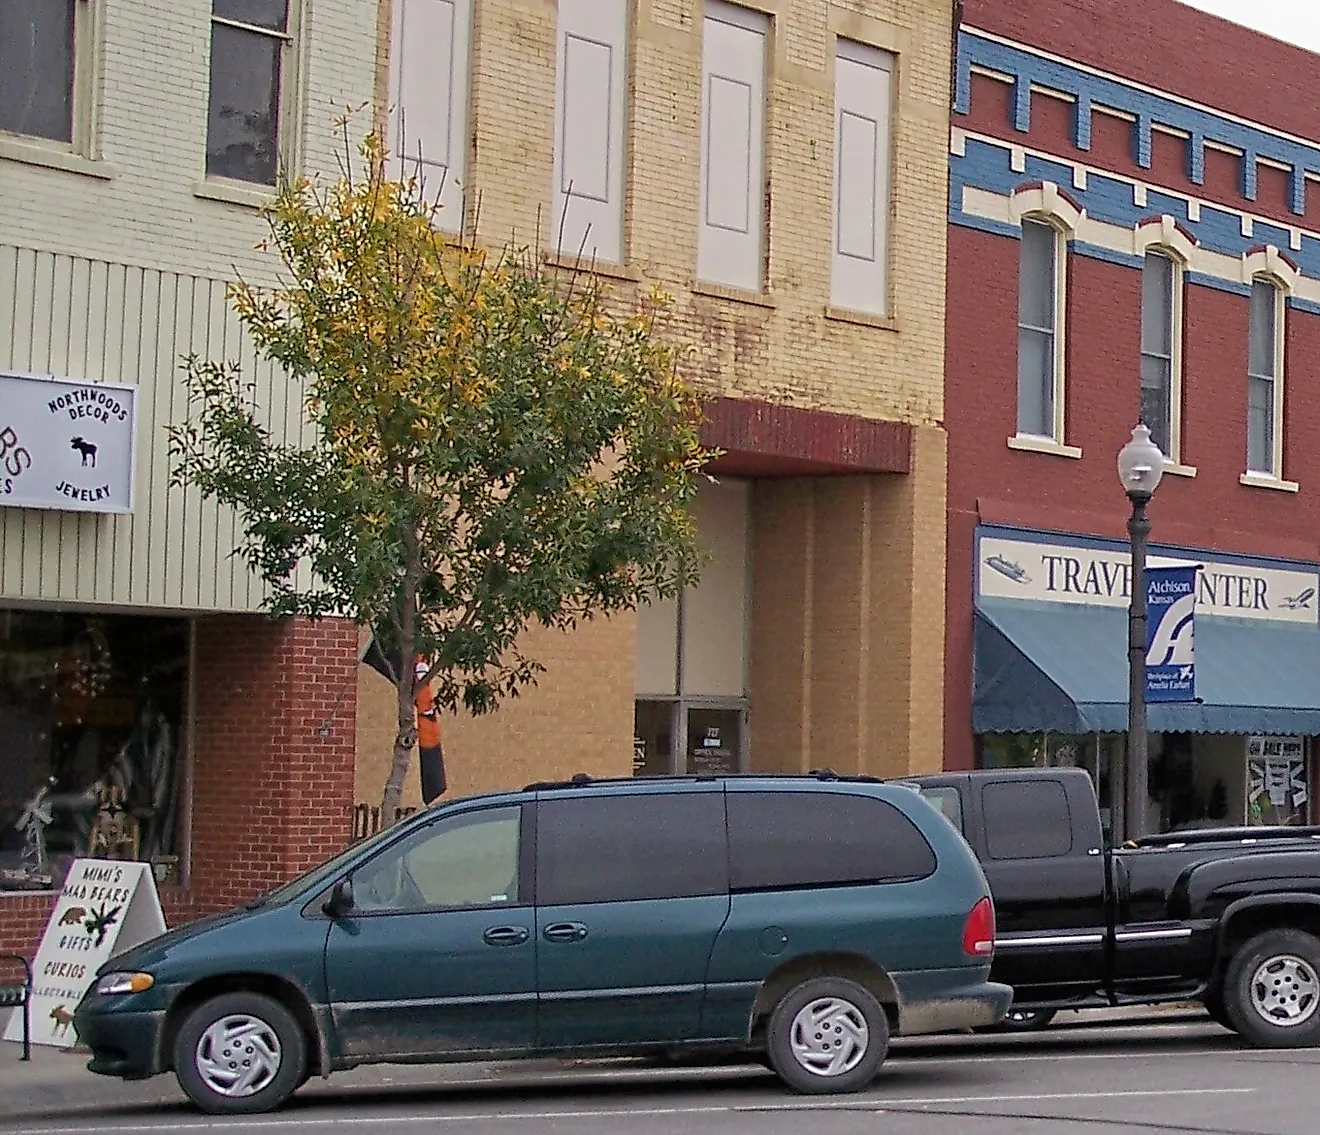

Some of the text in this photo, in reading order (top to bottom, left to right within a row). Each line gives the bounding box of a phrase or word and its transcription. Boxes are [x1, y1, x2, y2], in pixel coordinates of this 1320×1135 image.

[48, 388, 128, 421] NORTHWOODS
[68, 404, 110, 424] DECOR
[55, 480, 111, 502] JEWELRY
[1041, 554, 1270, 610] TRAVE NTER
[1148, 579, 1191, 593] Atchison
[83, 866, 123, 883] MIMI'S
[90, 886, 130, 903] BEARS
[60, 935, 93, 951] GIFTS
[44, 961, 86, 979] CURIOS
